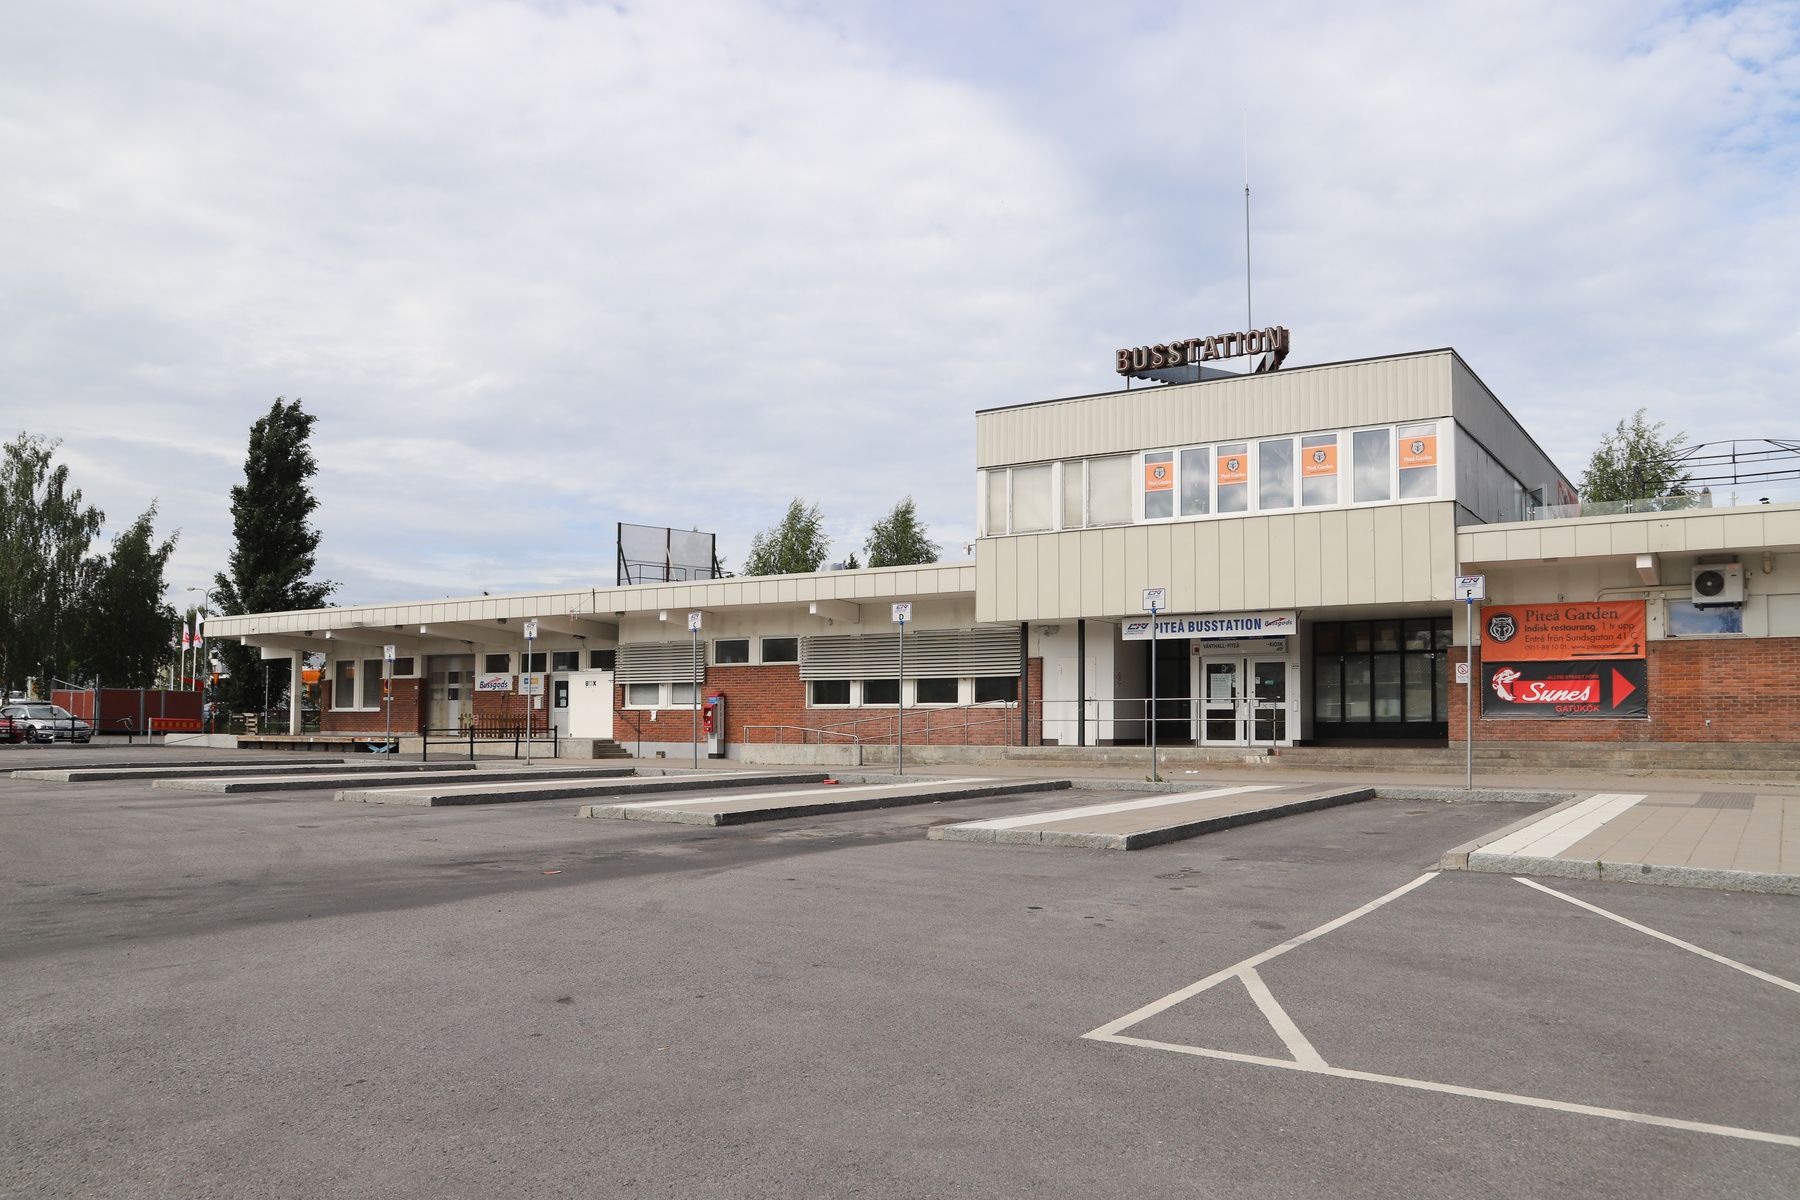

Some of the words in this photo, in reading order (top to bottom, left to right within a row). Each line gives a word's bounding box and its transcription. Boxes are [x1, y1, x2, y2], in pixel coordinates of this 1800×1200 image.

[1116, 326, 1284, 372] BUSSTATION
[1526, 609, 1560, 621] Piteå
[1565, 607, 1618, 620] Garden
[1155, 619, 1185, 633] PITEÅ
[1188, 619, 1261, 632] BUSSTATION
[1551, 624, 1598, 632] restaurang,
[1548, 633, 1563, 642] från
[1566, 633, 1613, 643] Sundsgatan
[480, 680, 508, 690] Bussgods
[1522, 682, 1591, 702] Sunes
[1555, 704, 1600, 712] GATUKÖK
